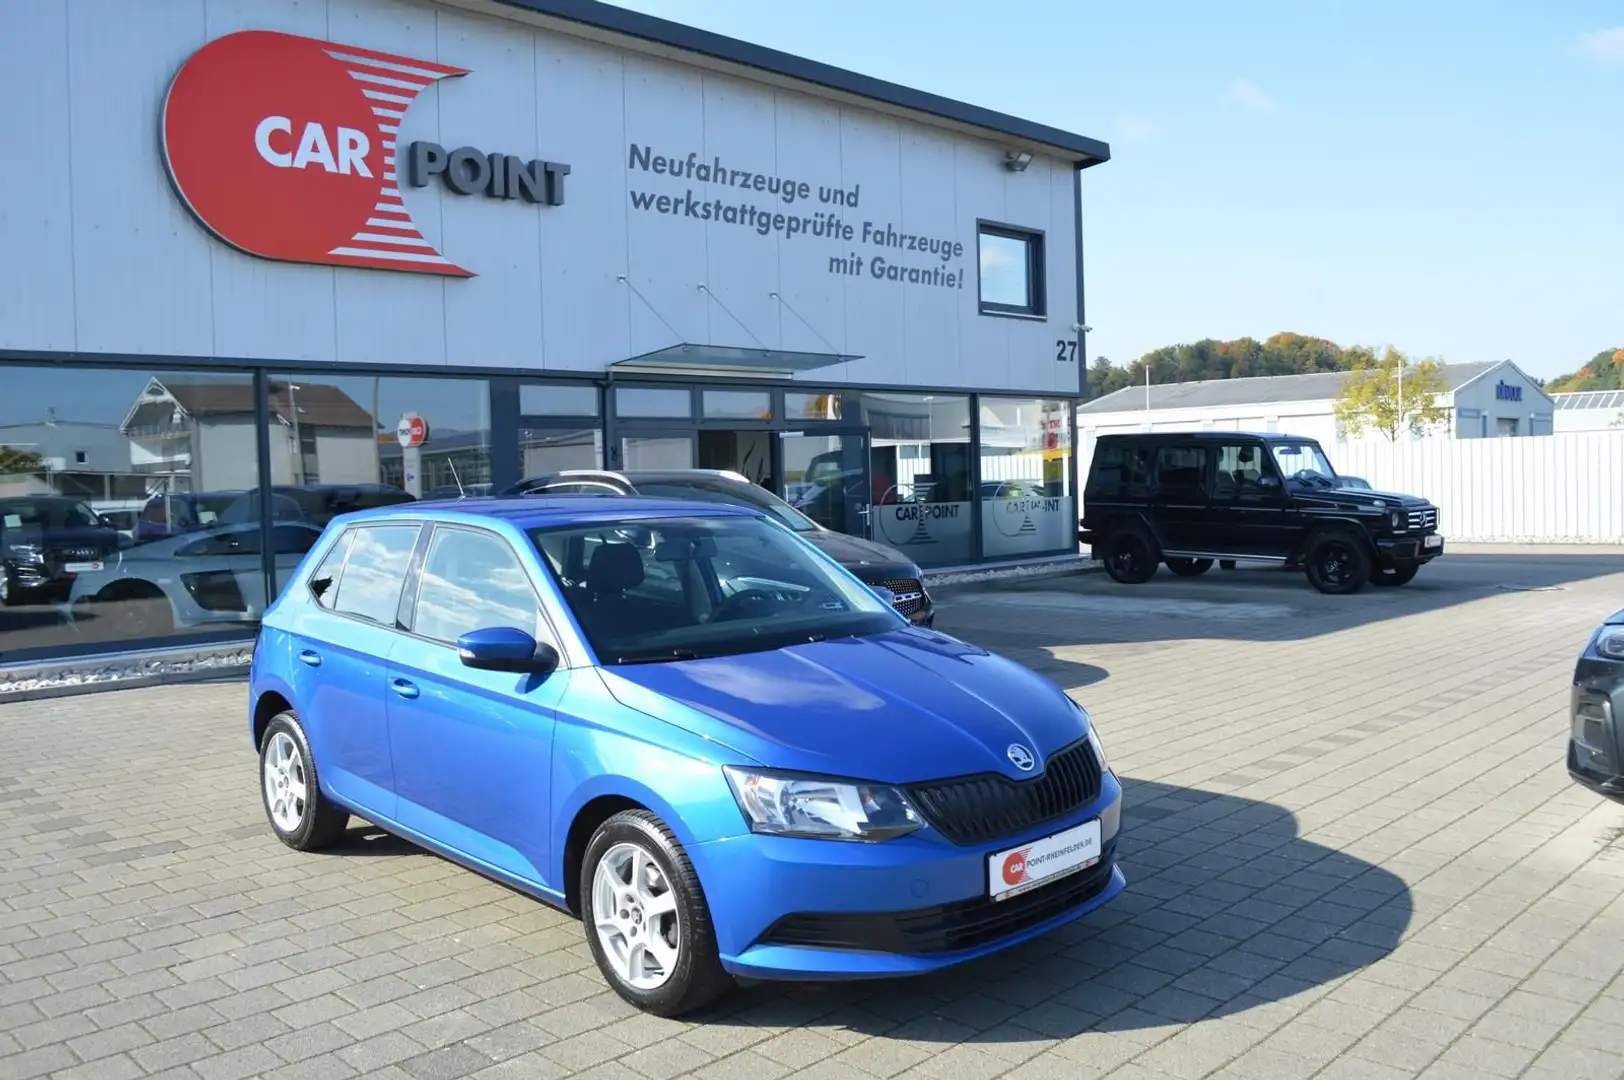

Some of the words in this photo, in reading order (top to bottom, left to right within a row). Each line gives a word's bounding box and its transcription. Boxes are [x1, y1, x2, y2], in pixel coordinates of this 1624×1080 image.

[254, 115, 374, 178] CAR
[410, 140, 571, 206] POINT
[628, 143, 810, 203] Neufahrzeuge
[818, 184, 860, 208] und
[630, 188, 854, 242] werkstattgeprüfte
[861, 221, 963, 261] Fahrzeuge
[828, 251, 863, 277] mit
[870, 256, 964, 289] Garantie!
[1055, 339, 1077, 362] 27
[895, 506, 919, 521] CAR
[925, 504, 960, 519] POINT
